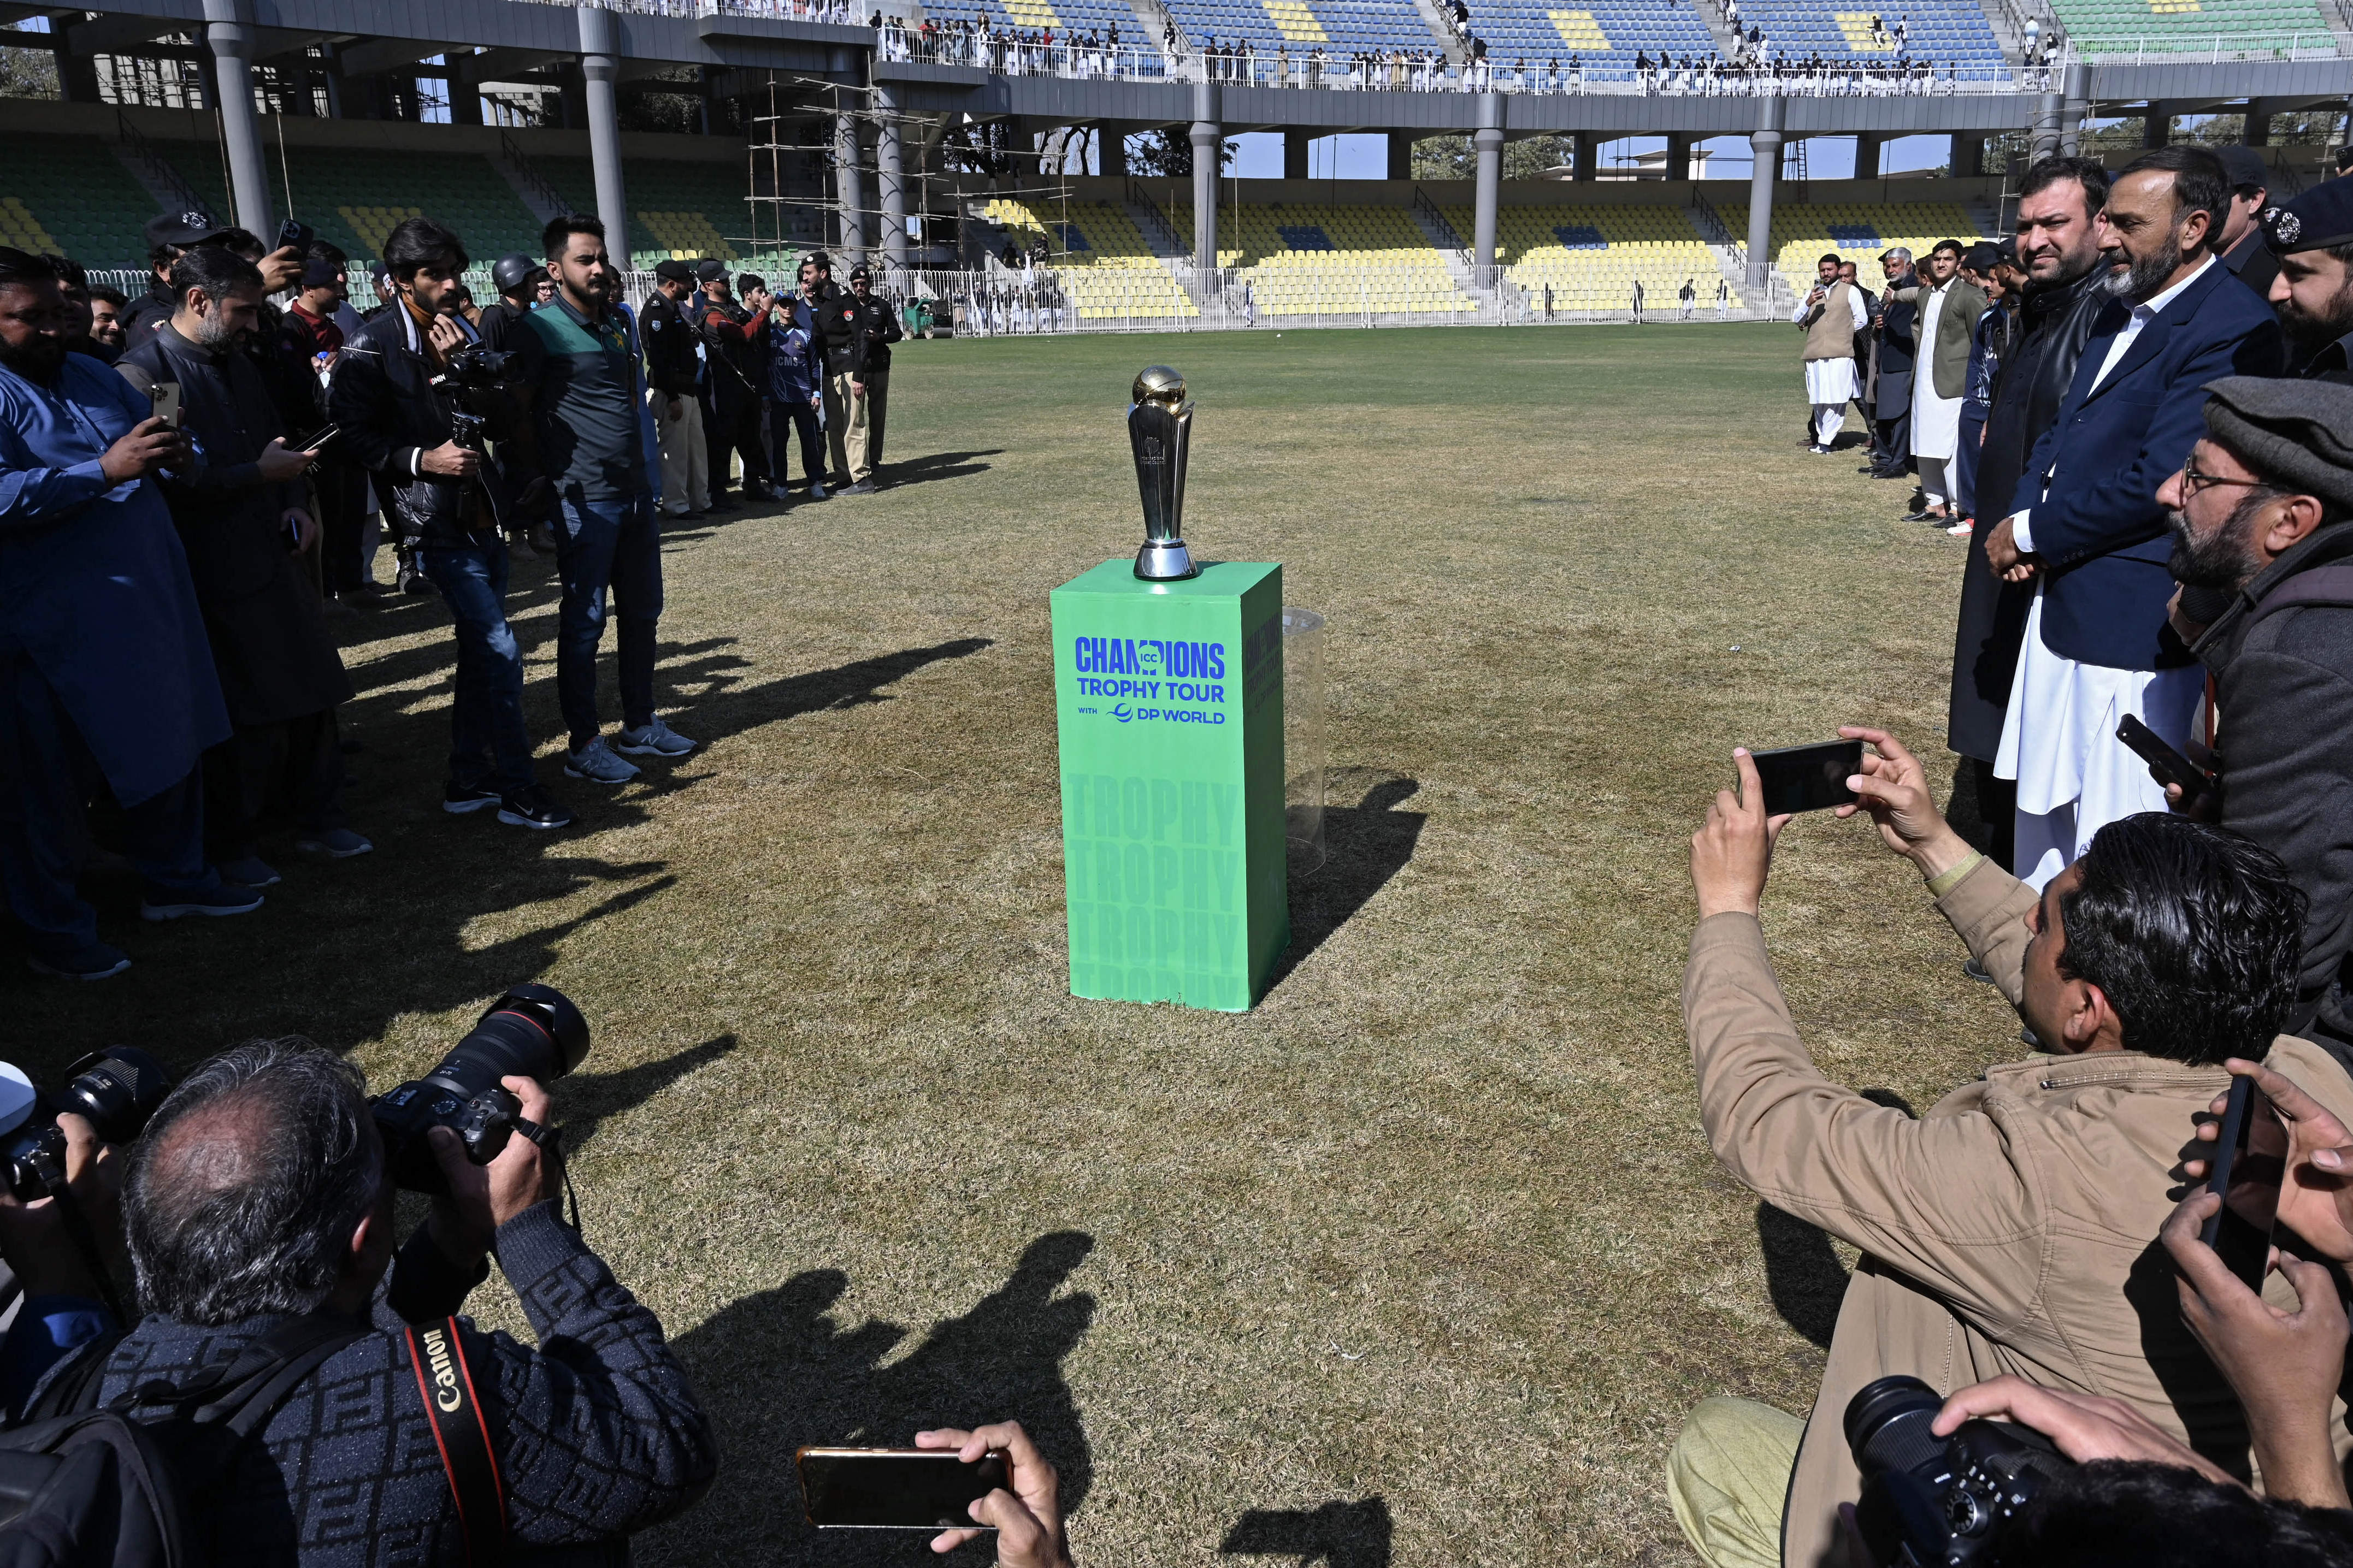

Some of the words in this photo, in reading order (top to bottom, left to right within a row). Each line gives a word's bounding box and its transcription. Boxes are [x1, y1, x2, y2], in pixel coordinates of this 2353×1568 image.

[1077, 677, 1161, 699] TROPHY
[1165, 682, 1225, 703] TOUR
[1140, 653, 1158, 662] ICC
[1137, 708, 1160, 720] DP
[1162, 709, 1225, 725] WORLD
[1066, 773, 1239, 846] TROPHY
[1069, 839, 1239, 912] TROPHY
[1071, 901, 1240, 975] TROPHY
[423, 1328, 462, 1412] Canon
